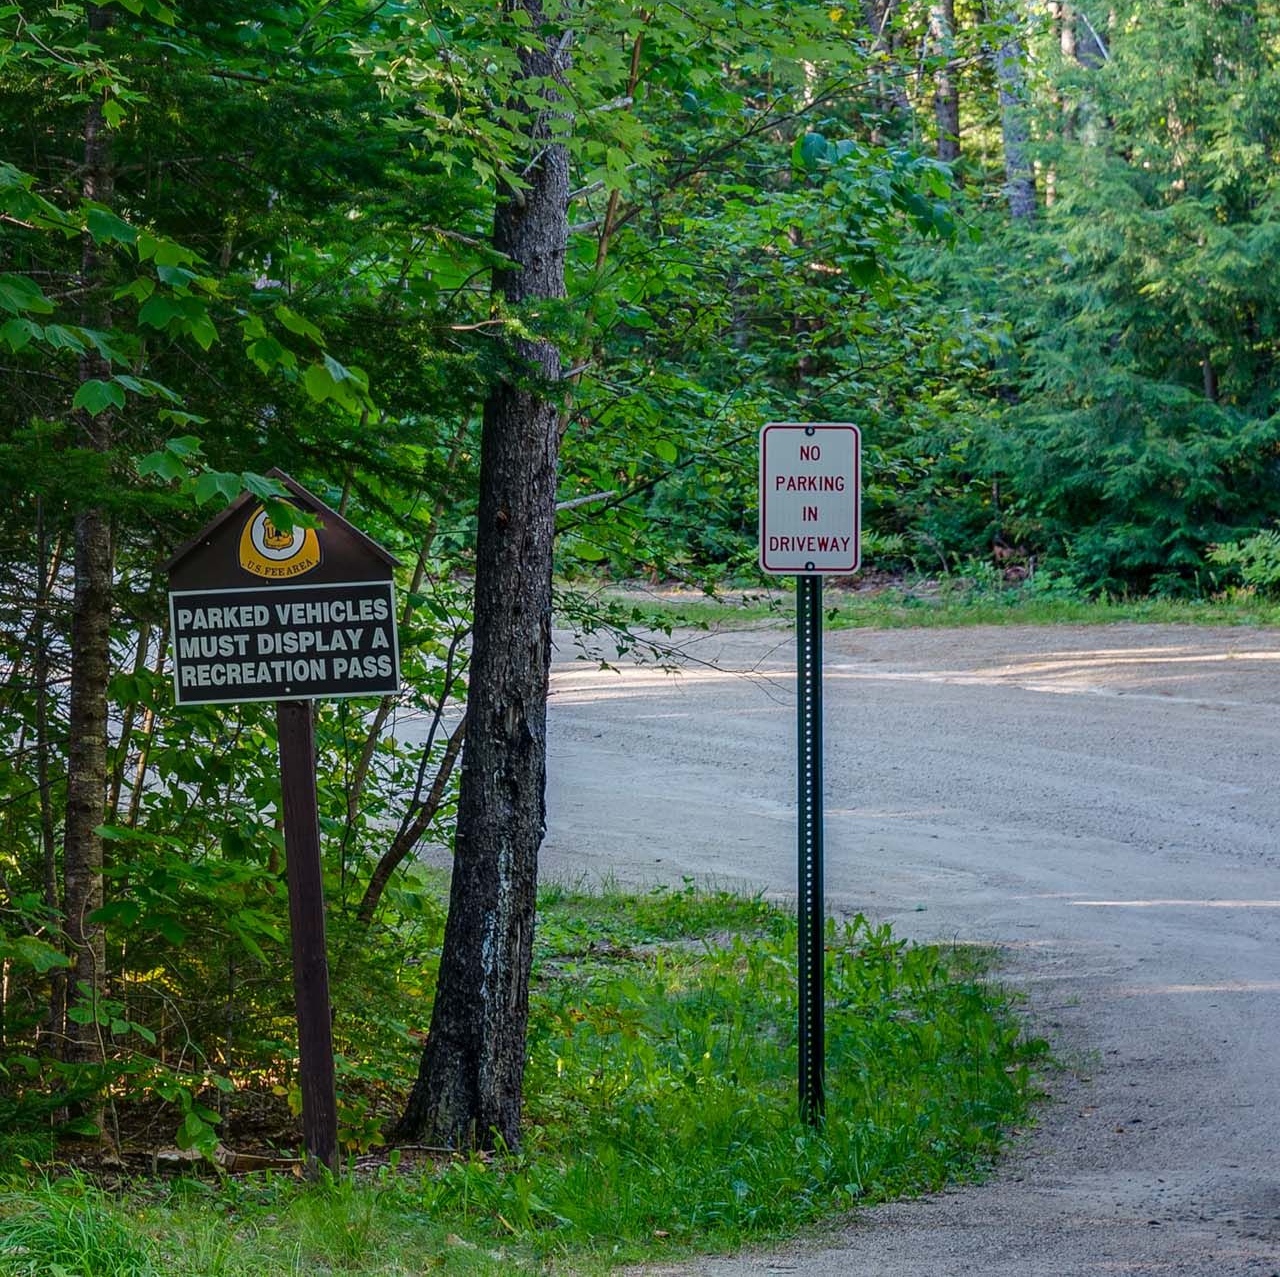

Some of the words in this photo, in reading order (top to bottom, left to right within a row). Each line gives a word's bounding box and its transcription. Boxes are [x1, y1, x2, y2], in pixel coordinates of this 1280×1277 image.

[799, 445, 821, 461] NO
[775, 476, 845, 492] PARKING
[802, 506, 818, 522] IN
[769, 536, 851, 552] DRIVEWAY
[264, 566, 286, 576] FEE
[286, 559, 313, 575] AREA
[177, 605, 270, 631] PARKED
[275, 598, 389, 626] VEHICLES
[179, 635, 250, 658] MUST
[257, 628, 365, 654] DISPLAY
[371, 627, 390, 649] A
[181, 660, 327, 687] RECREATION
[333, 654, 393, 680] PASS
